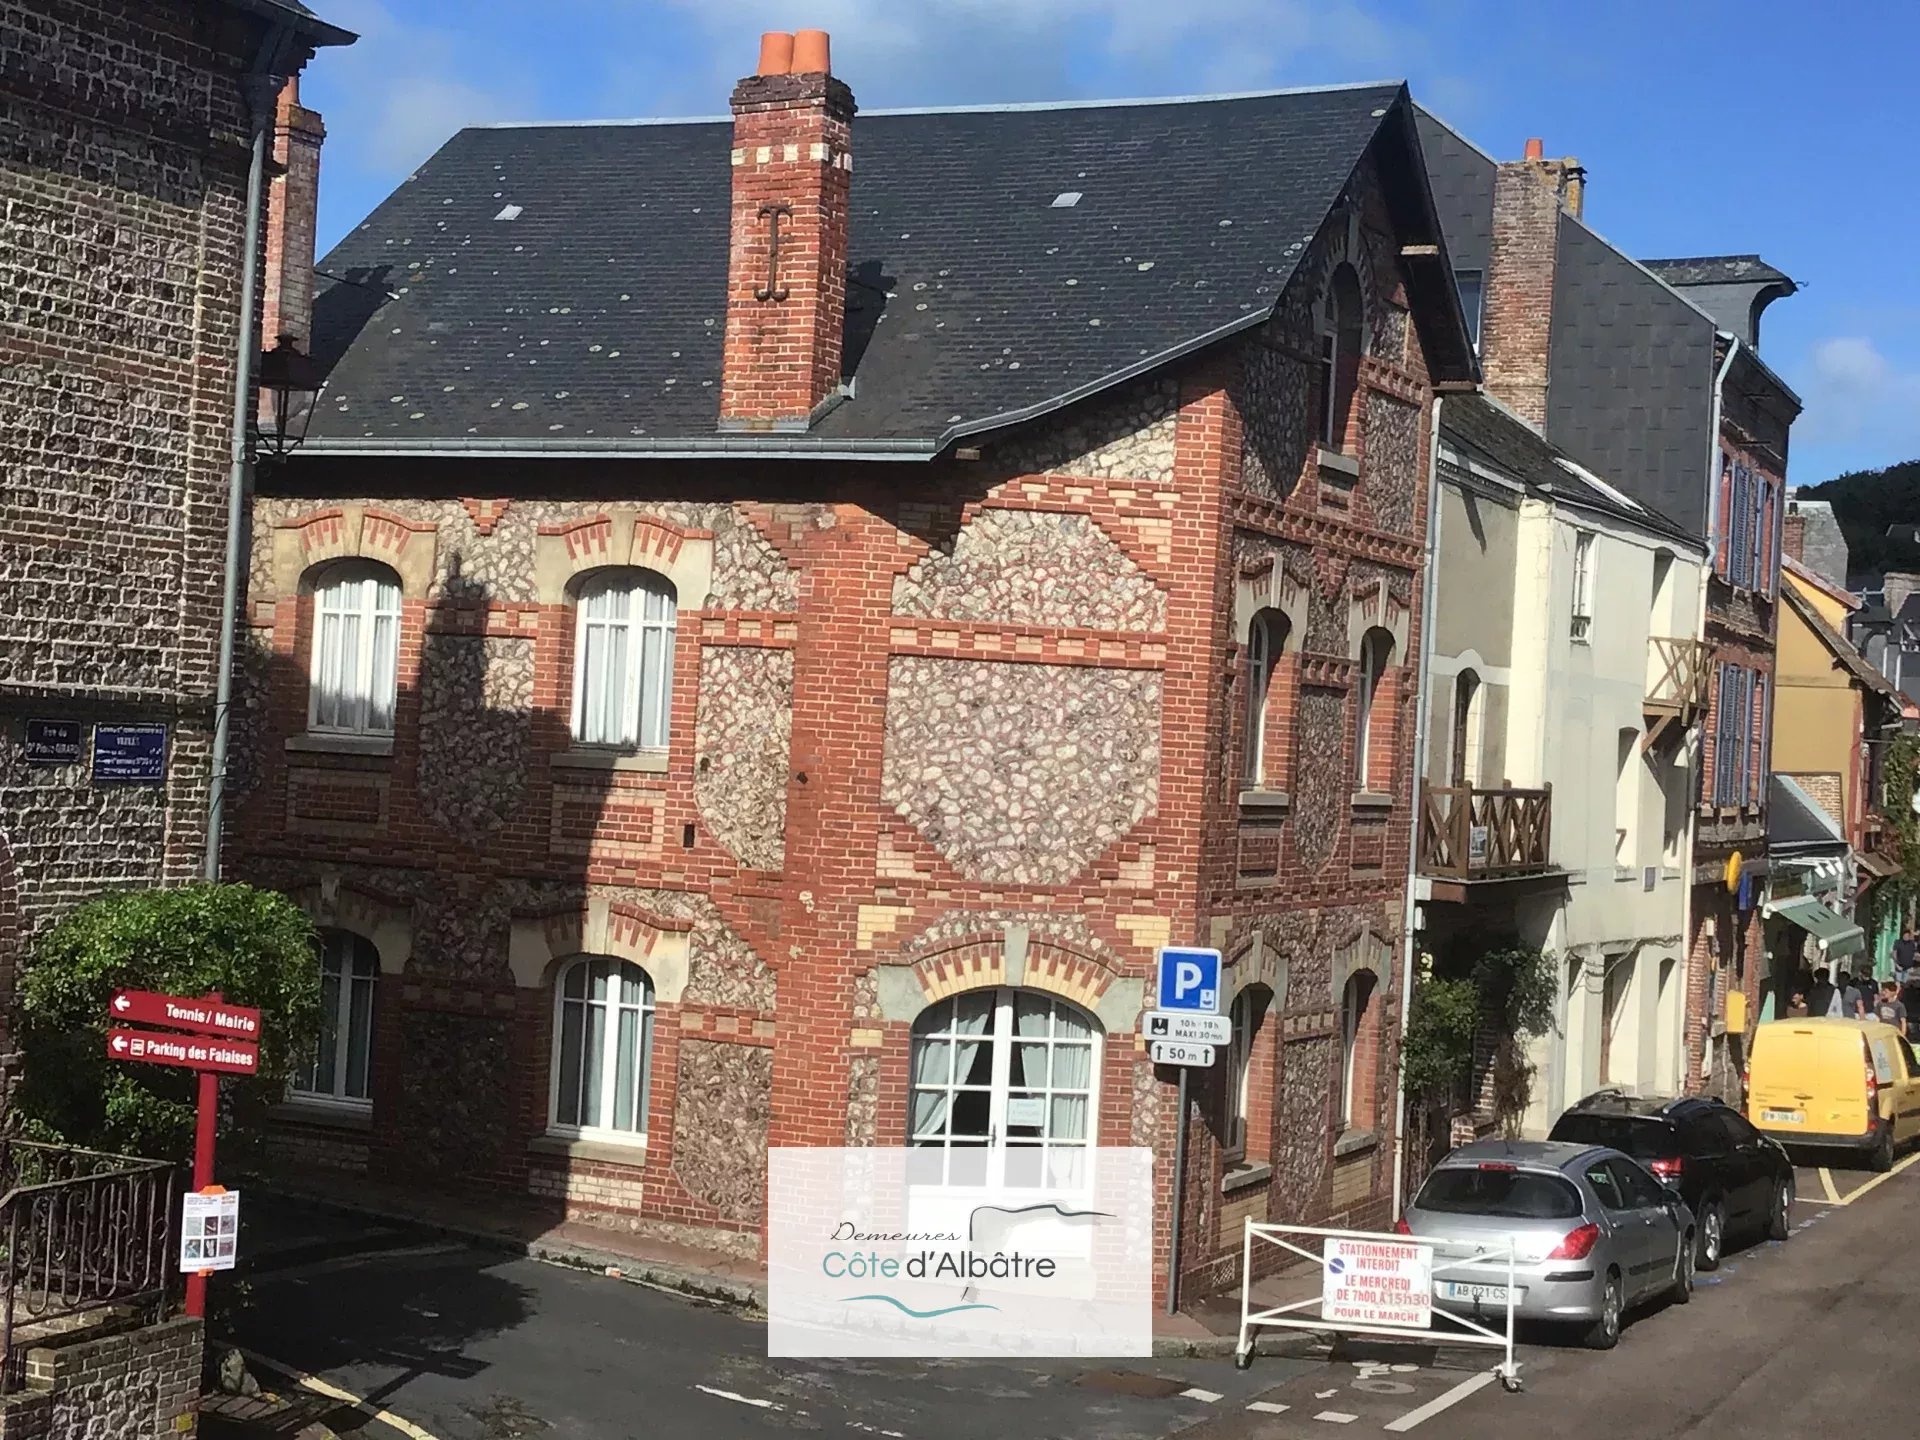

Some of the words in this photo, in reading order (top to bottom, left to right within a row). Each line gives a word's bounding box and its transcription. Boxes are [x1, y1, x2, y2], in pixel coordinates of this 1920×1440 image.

[1175, 962, 1202, 1000] P
[166, 1003, 205, 1023] Tennis
[214, 1012, 256, 1031] Mairie
[1175, 1029, 1197, 1038] MAXI
[147, 1040, 186, 1061] Parking
[188, 1046, 207, 1061] des
[209, 1047, 253, 1066] Falaises
[1169, 1048, 1186, 1059] 50
[1339, 1243, 1419, 1260] STATIONNEMENT
[1356, 1257, 1400, 1271] INTERDIT
[1345, 1274, 1356, 1287] LE
[1359, 1275, 1410, 1290] MERCREDI
[1336, 1288, 1349, 1301] DE
[1353, 1289, 1376, 1303] 7h00
[1388, 1292, 1429, 1306] 15h30
[1334, 1307, 1361, 1318] POUR
[1364, 1309, 1375, 1319] LE
